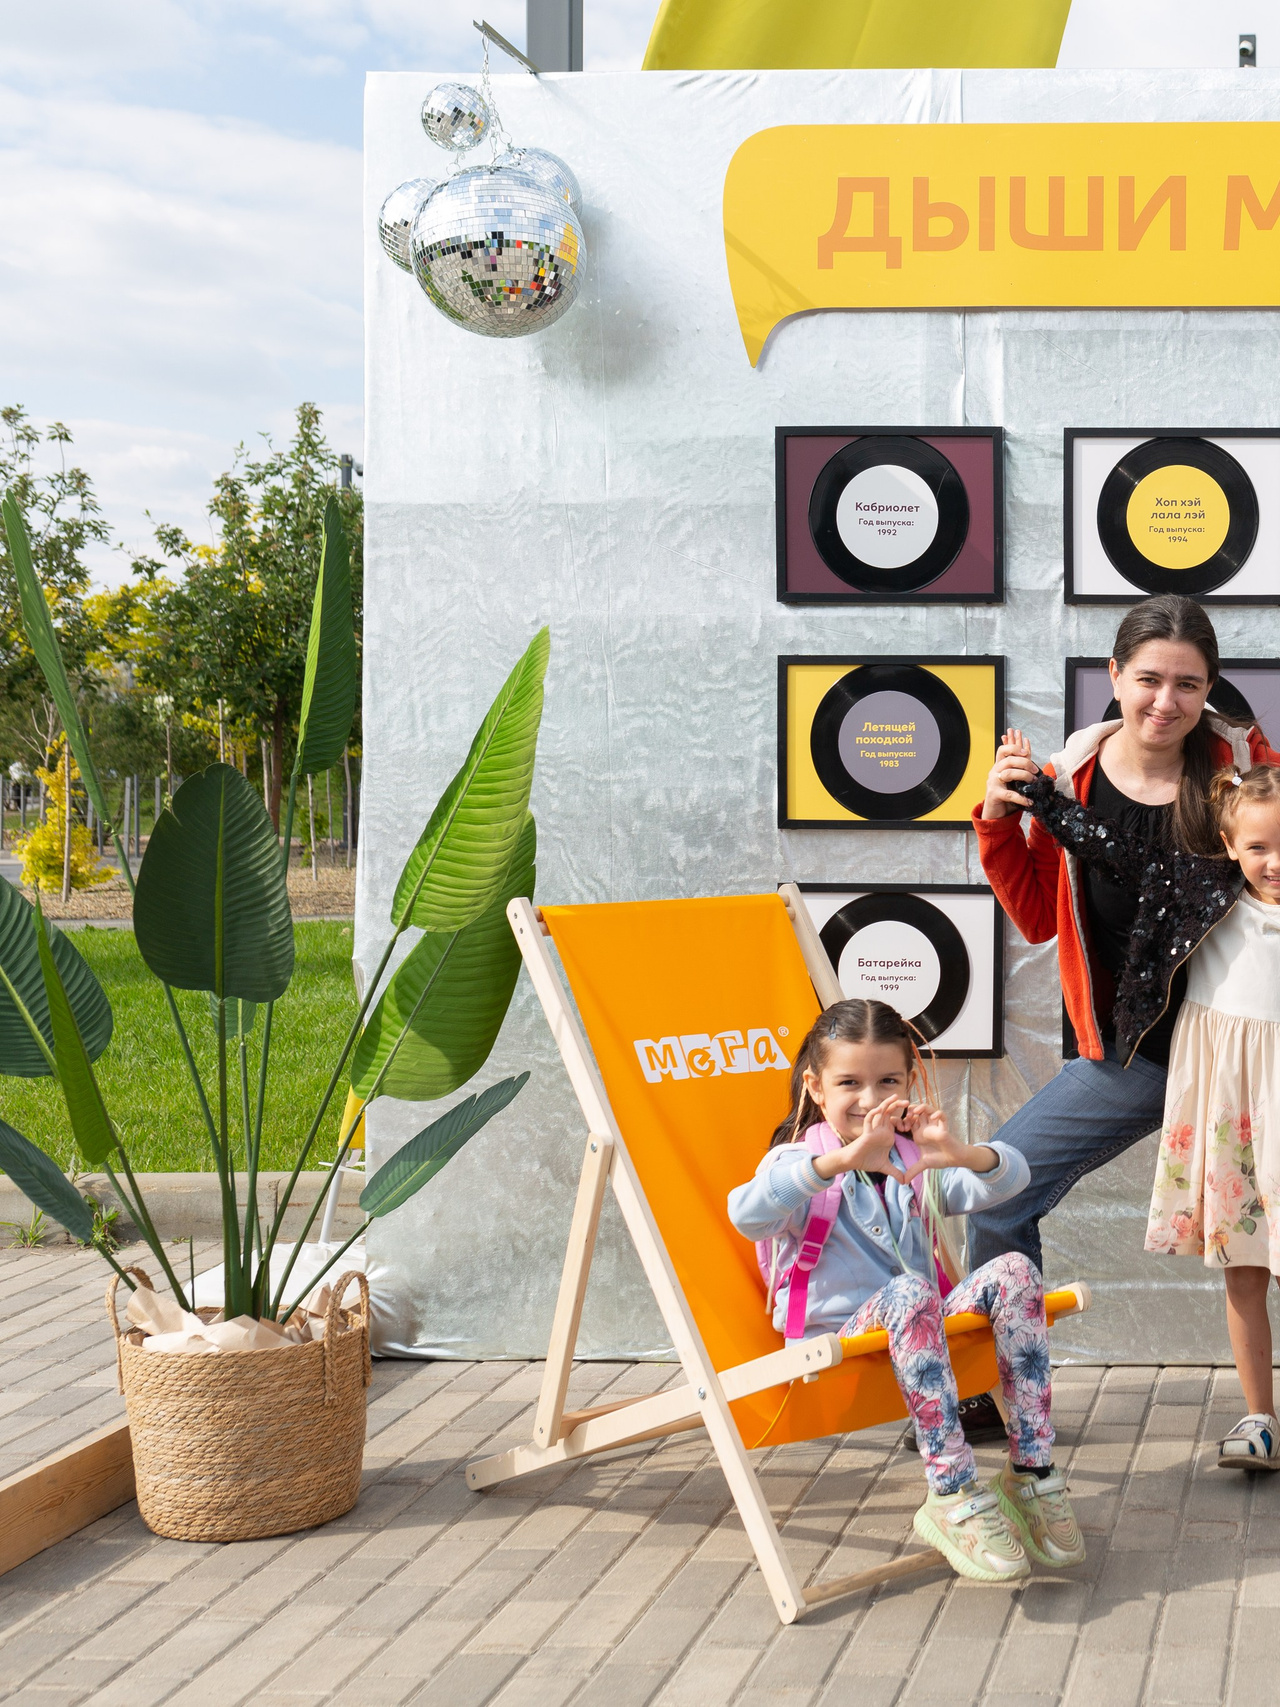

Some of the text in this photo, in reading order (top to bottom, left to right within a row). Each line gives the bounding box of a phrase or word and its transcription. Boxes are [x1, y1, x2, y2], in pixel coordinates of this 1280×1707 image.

[816, 175, 1188, 270] ДЫШИ
[1155, 498, 1201, 507] Хоп хэй
[856, 502, 920, 513] Кабриолет
[1151, 510, 1205, 520] лала лэй
[859, 518, 914, 528] Год выпуска:
[878, 529, 897, 537] 1992
[1149, 526, 1164, 534] Год
[862, 722, 916, 733] Летящей
[856, 735, 913, 745] походкой
[860, 750, 876, 759] Год
[880, 760, 899, 768] 1983
[858, 958, 921, 969] Батарейка
[861, 974, 876, 982] Год
[880, 984, 899, 992] 1999
